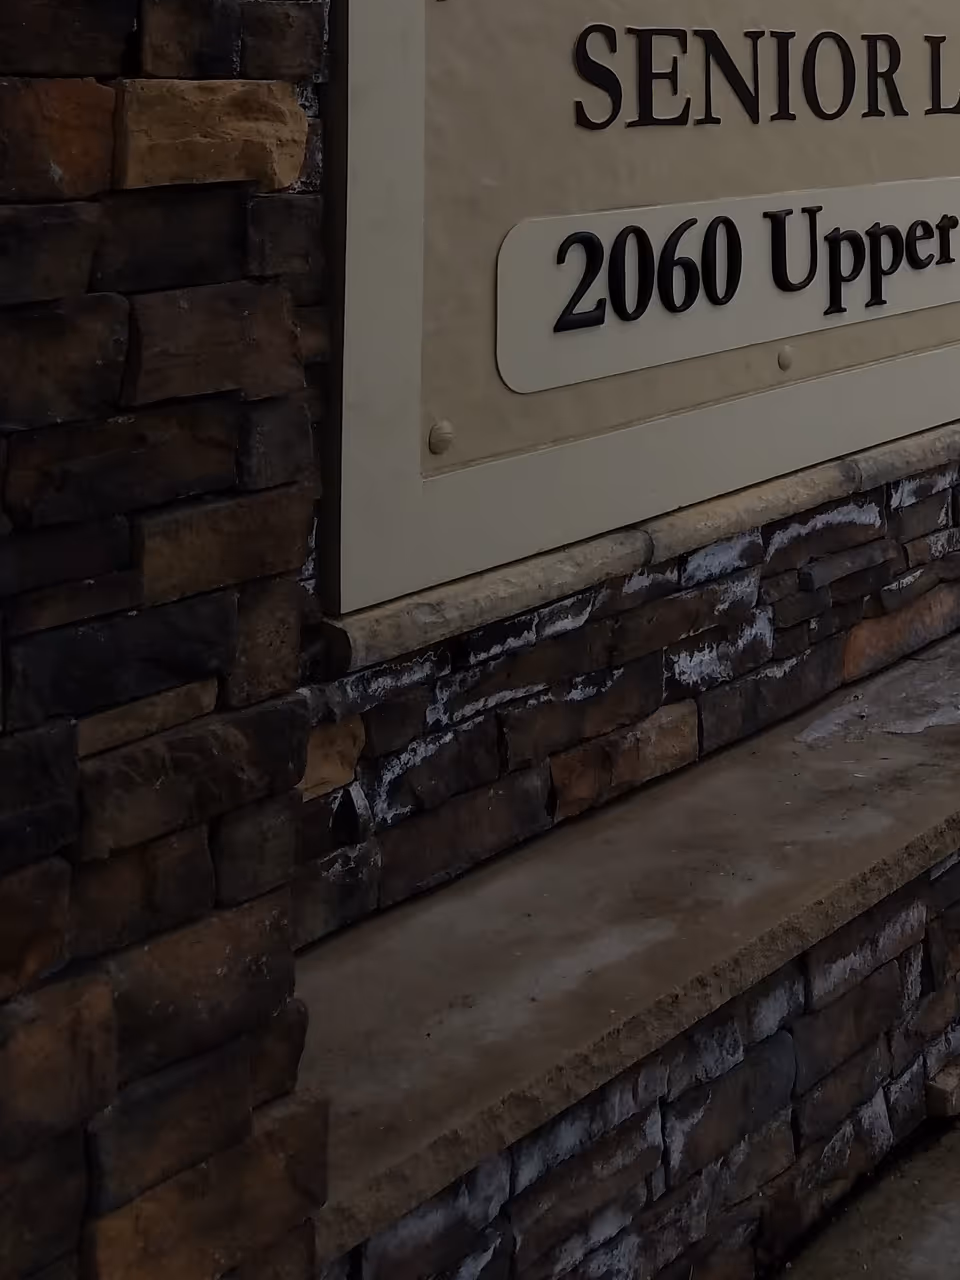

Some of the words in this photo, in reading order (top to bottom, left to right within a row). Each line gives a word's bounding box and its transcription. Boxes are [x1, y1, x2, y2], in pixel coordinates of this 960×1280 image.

[573, 23, 908, 131] SENIOR
[552, 215, 743, 333] 2060
[763, 205, 959, 316] Upper
